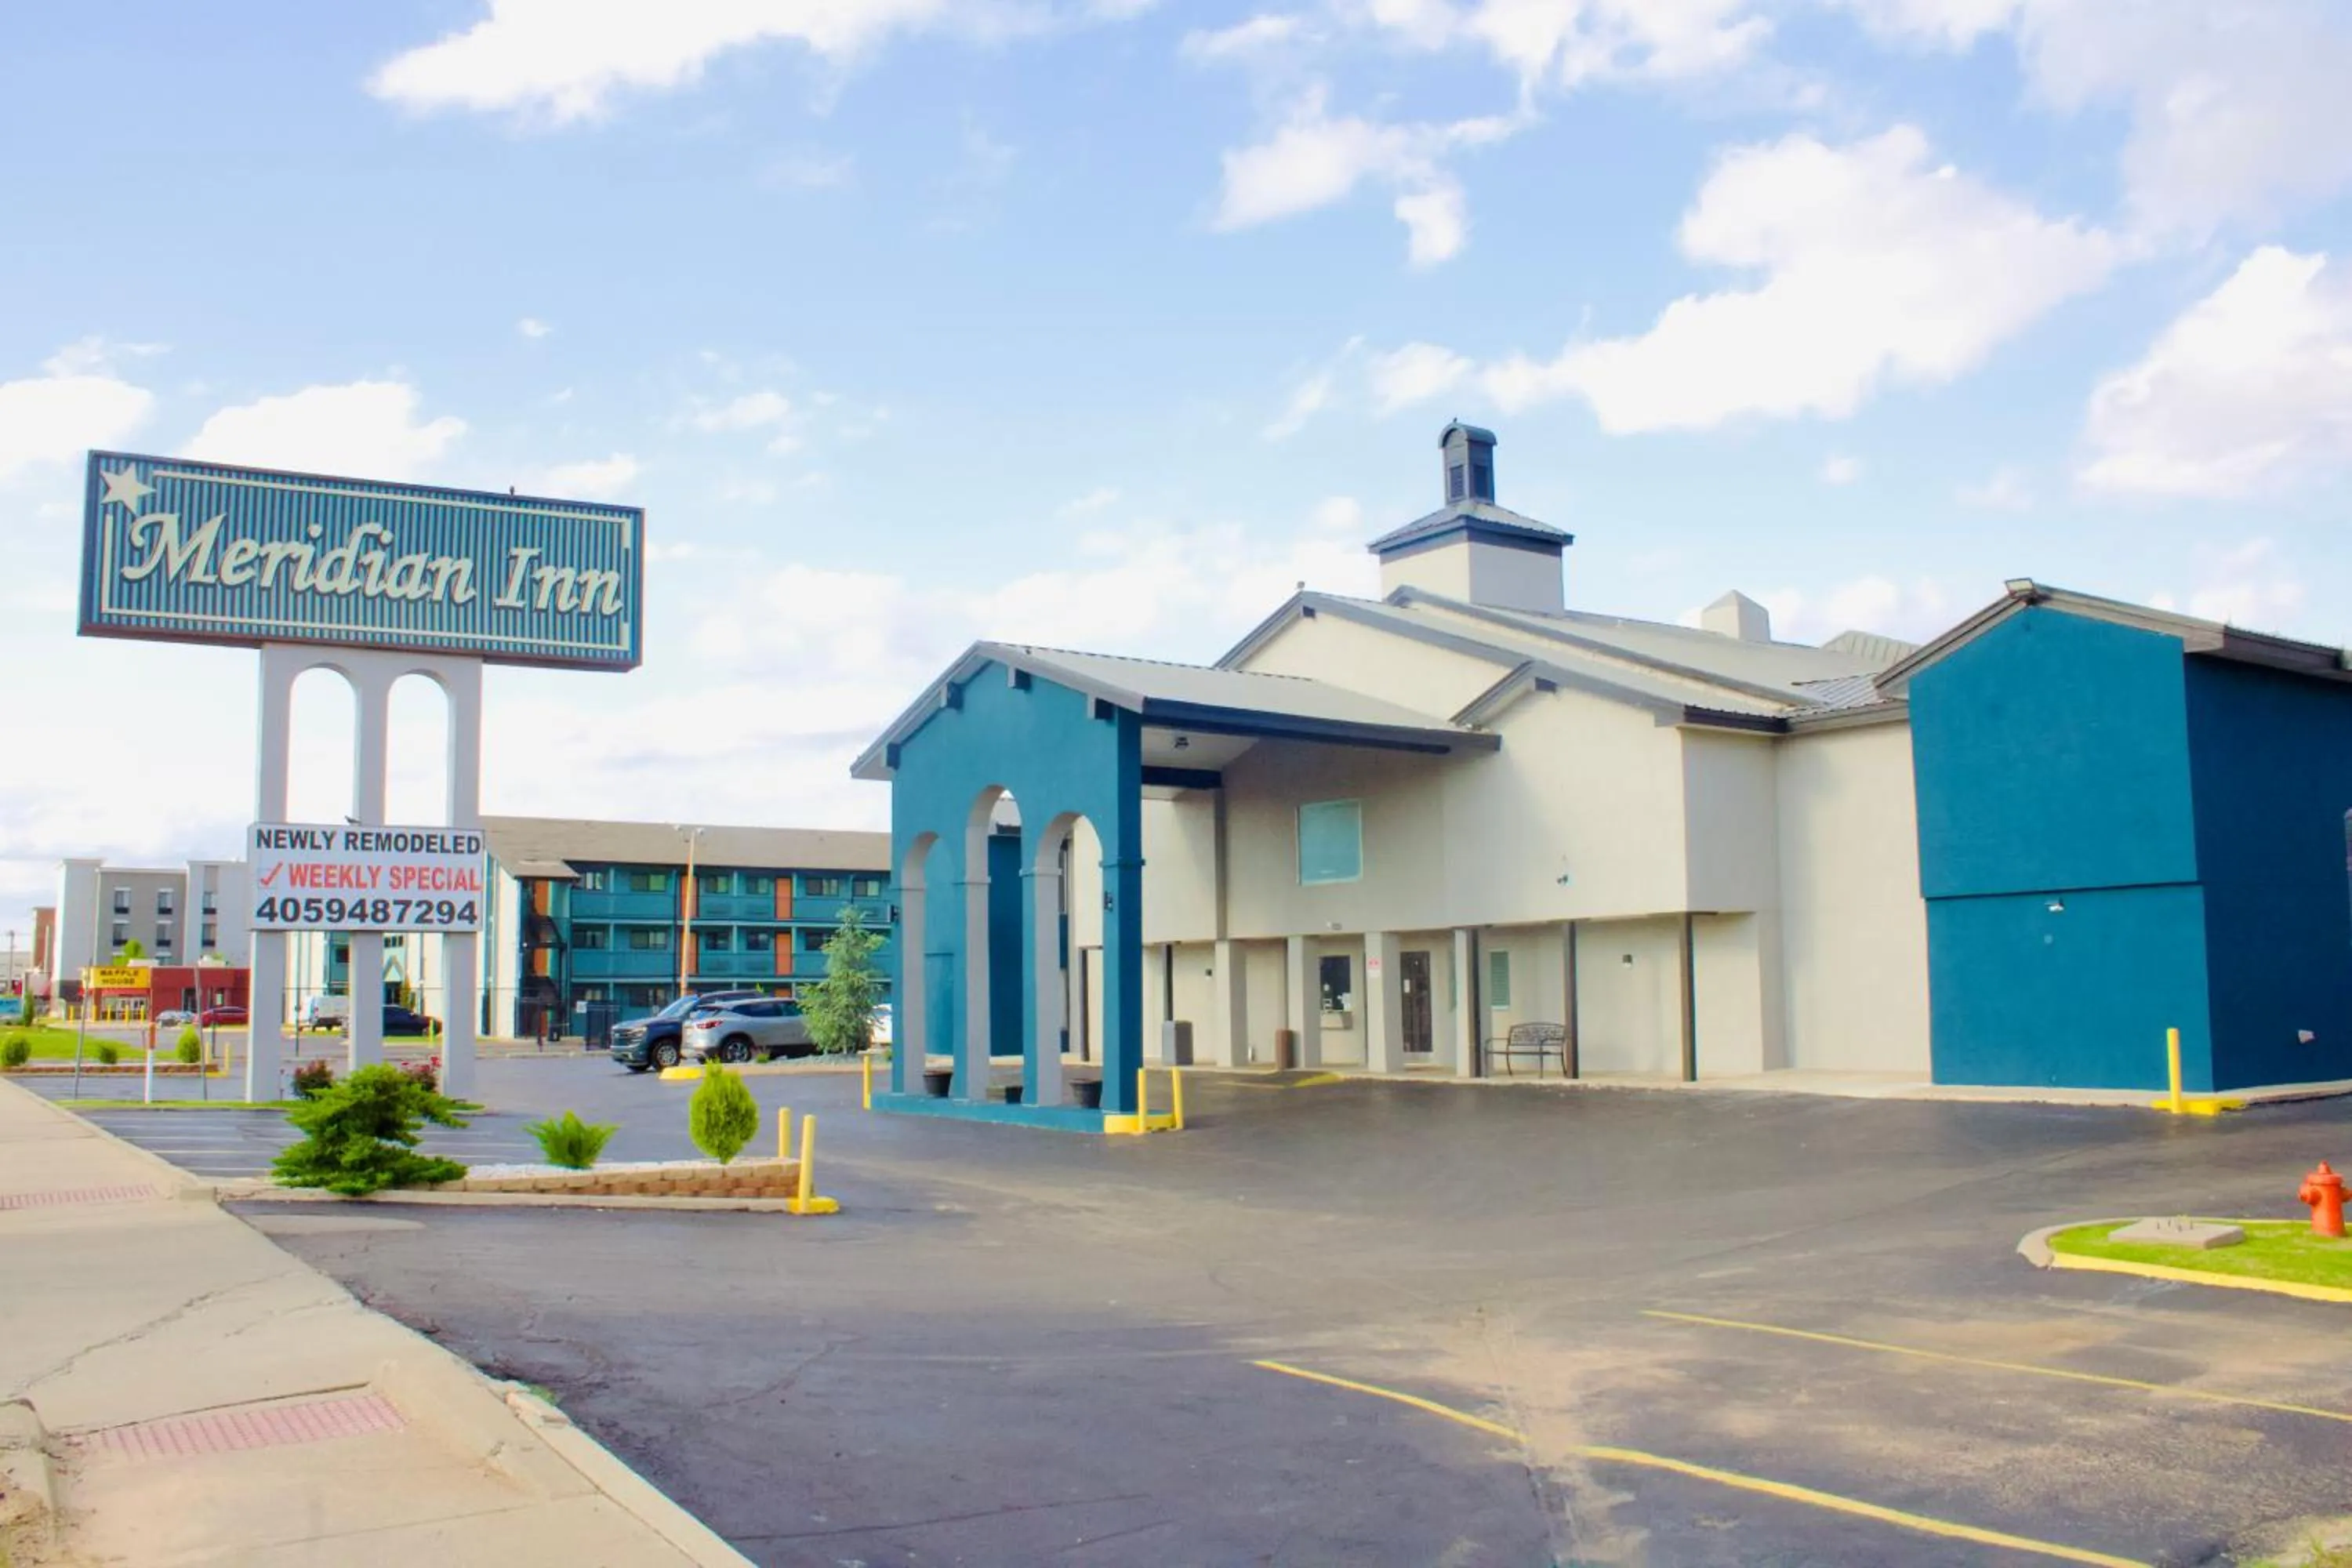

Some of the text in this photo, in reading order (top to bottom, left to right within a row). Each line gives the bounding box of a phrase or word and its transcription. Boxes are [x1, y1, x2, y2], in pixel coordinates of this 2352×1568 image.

[121, 512, 624, 616] Meridian Inn
[256, 829, 481, 855] NEWLY REMODELED
[289, 863, 484, 891] WEEKLY SPECIAL
[256, 897, 478, 924] 4059487294
